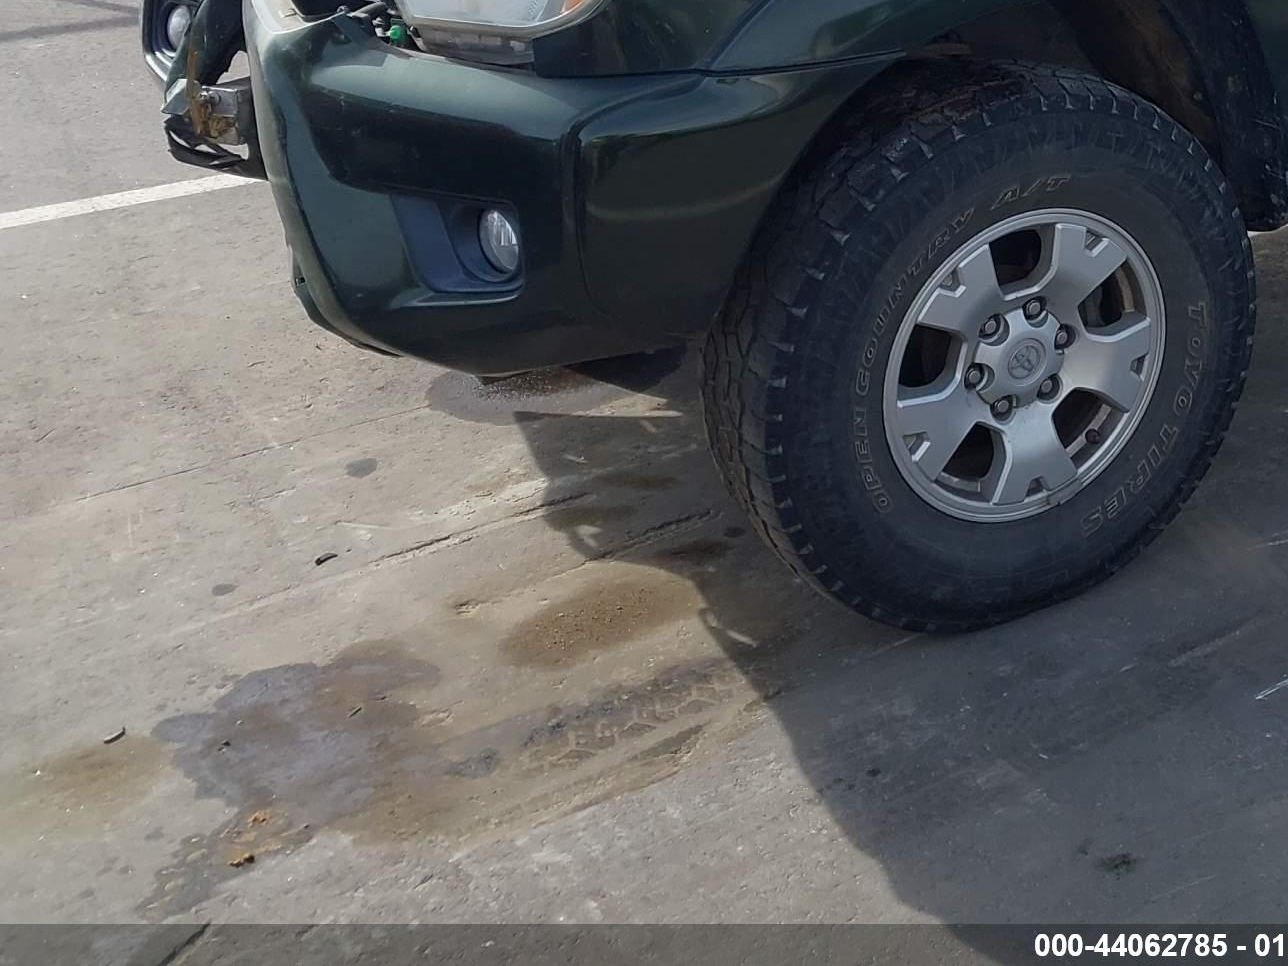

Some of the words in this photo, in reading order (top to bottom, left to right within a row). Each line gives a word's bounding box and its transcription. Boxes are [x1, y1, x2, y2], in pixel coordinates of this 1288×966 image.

[991, 173, 1073, 211] A/T
[854, 207, 977, 397] COUNTRY
[1171, 299, 1210, 417] TOYO
[851, 405, 891, 514] OPEN
[1081, 422, 1179, 539] TIRES
